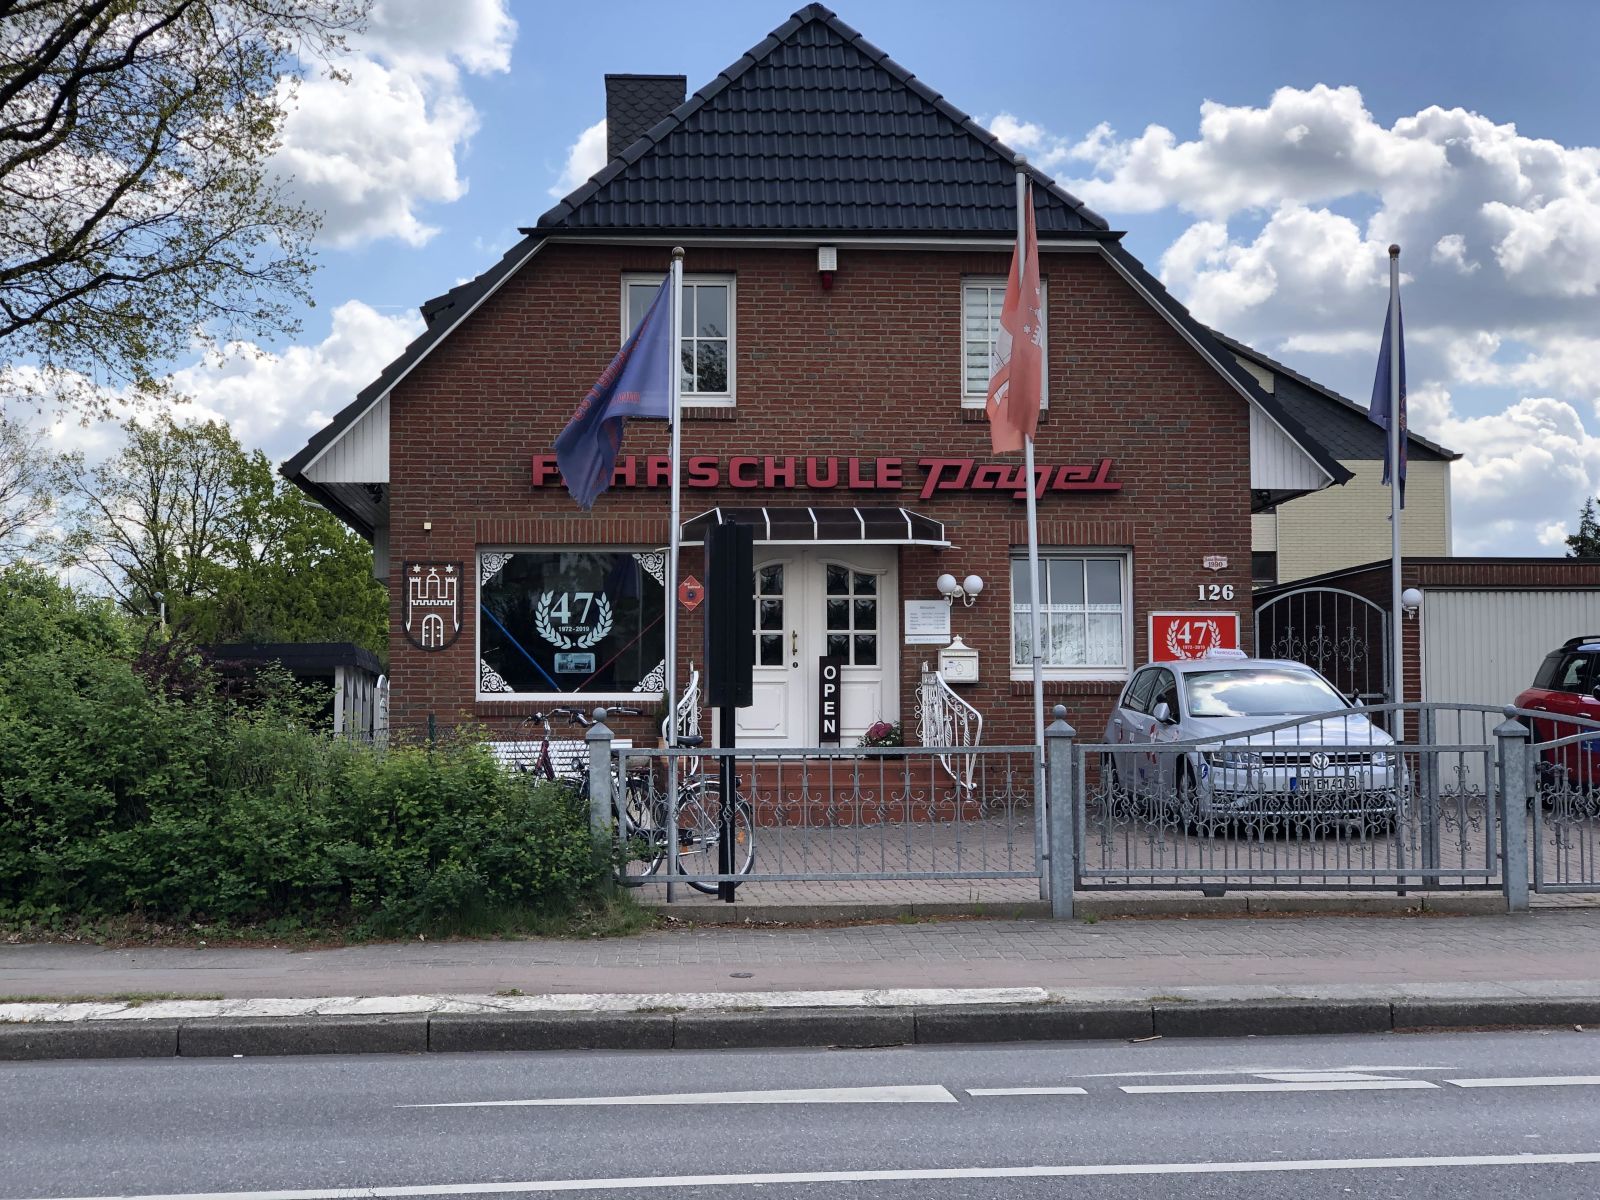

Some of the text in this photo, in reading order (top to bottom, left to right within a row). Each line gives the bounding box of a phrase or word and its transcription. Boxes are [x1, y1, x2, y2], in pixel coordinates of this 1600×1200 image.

[532, 455, 1124, 499] FHRSCHULE Pagel
[550, 592, 594, 624] 47
[1198, 584, 1234, 600] 126
[1177, 621, 1208, 644] 47
[823, 665, 837, 733] OPEN
